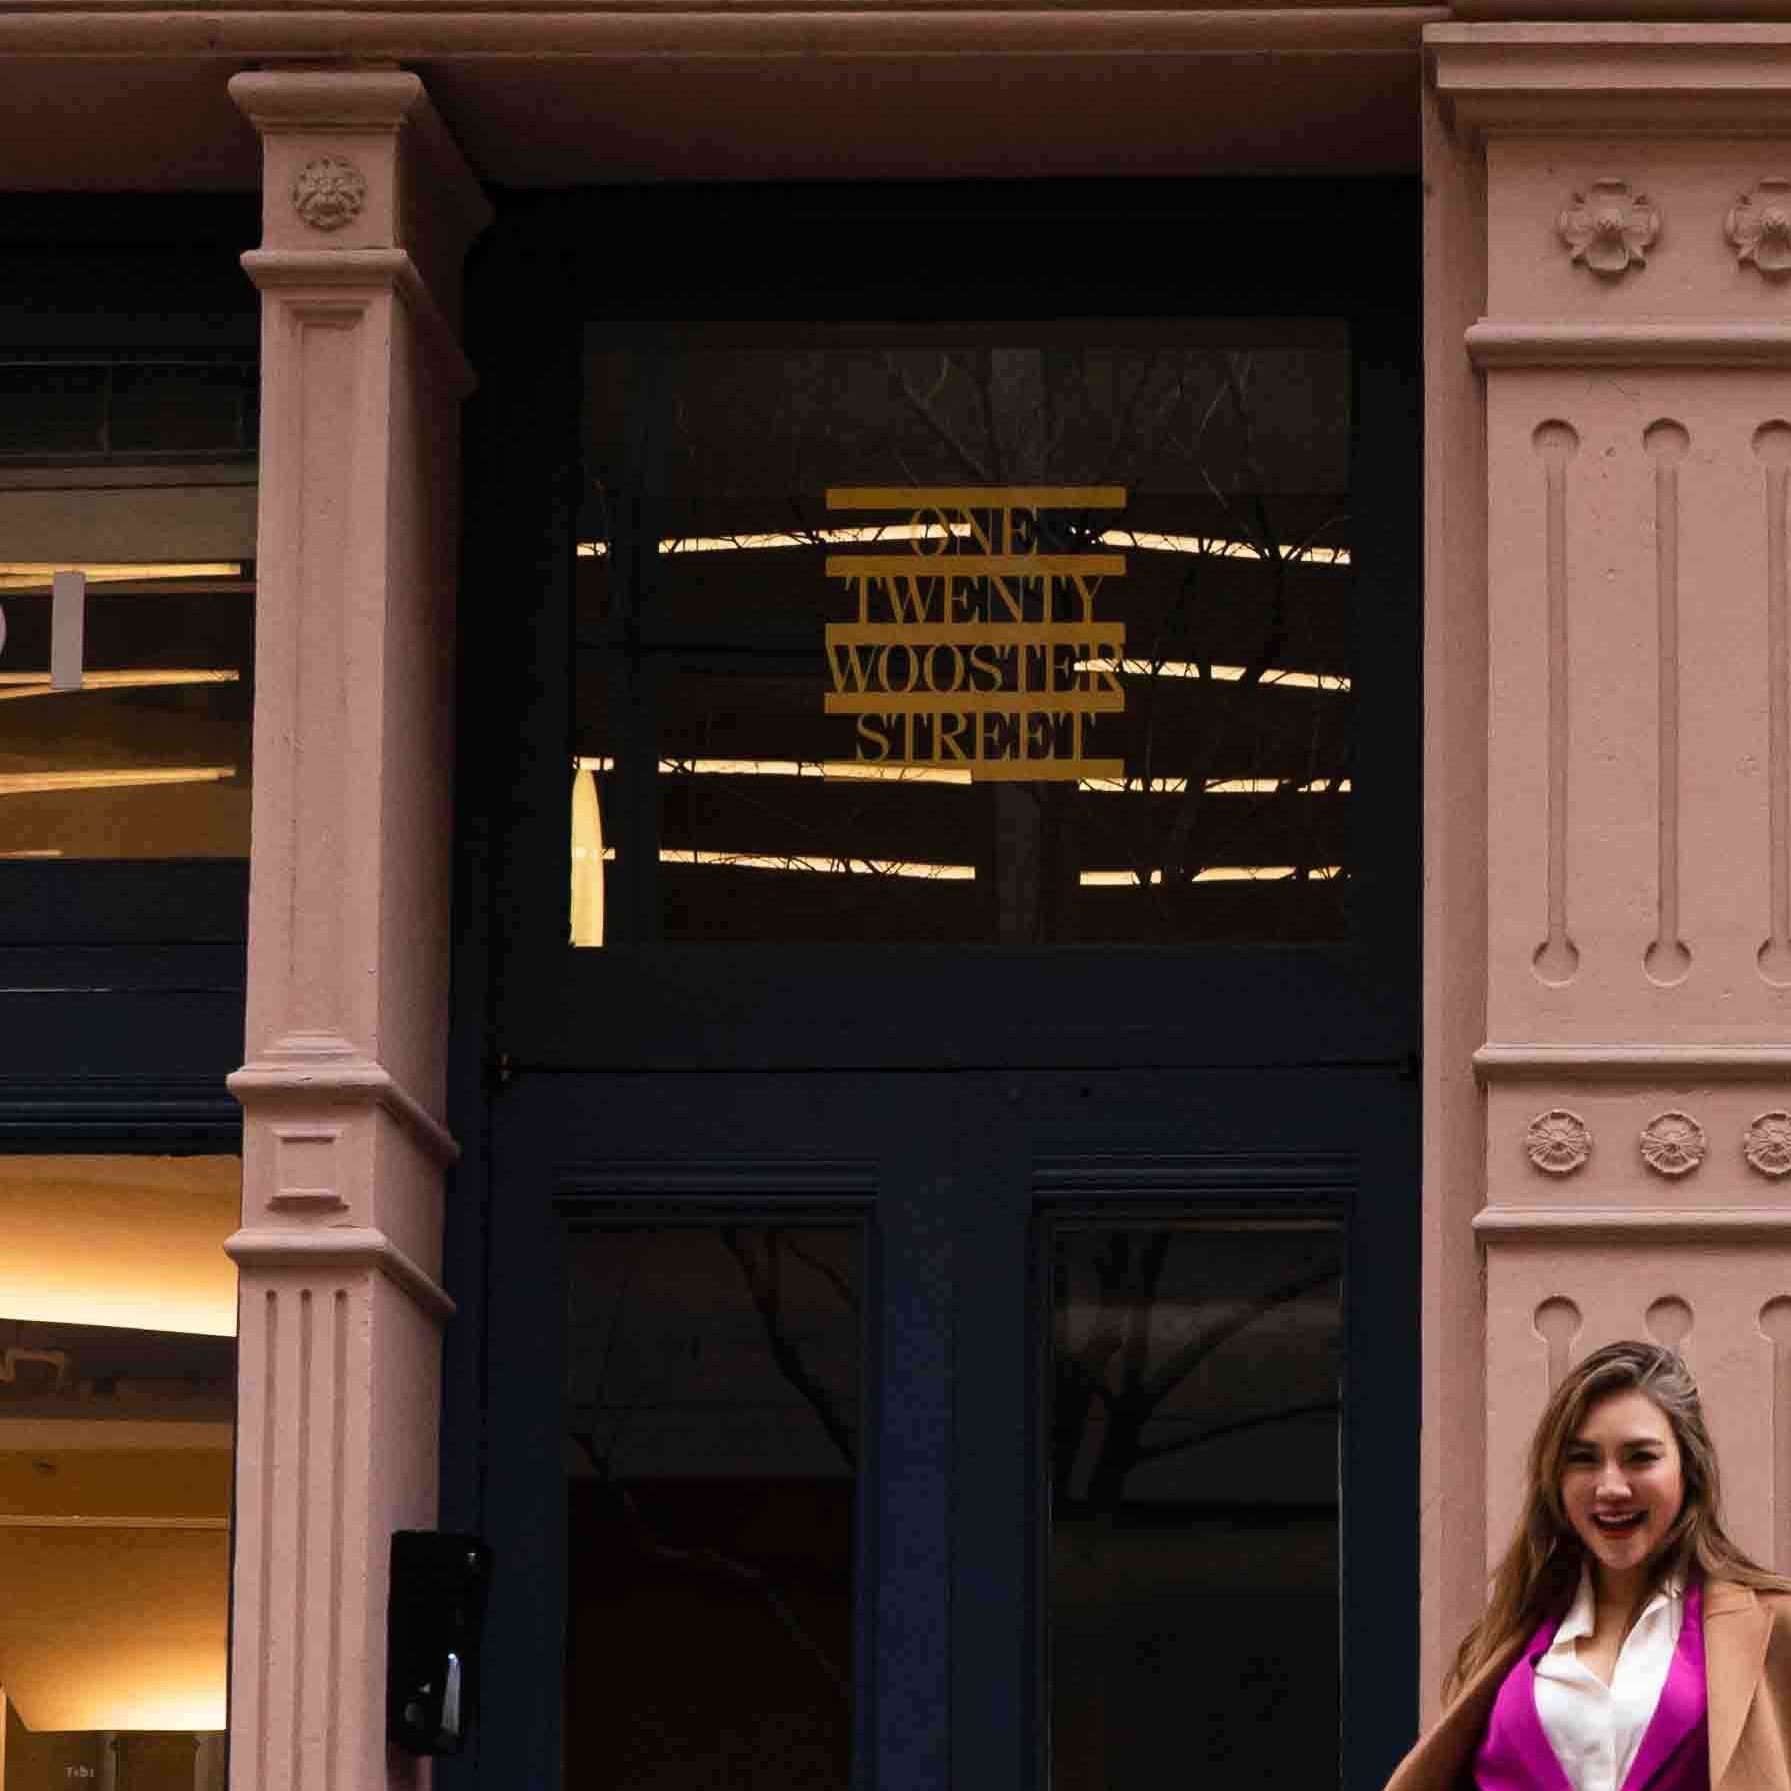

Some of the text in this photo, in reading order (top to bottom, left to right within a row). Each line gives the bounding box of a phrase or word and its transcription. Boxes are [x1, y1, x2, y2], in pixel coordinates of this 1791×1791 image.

[909, 506, 1038, 557] ONE
[844, 575, 1104, 624] TWENTY
[826, 642, 1124, 693] WOOSTER
[855, 711, 1096, 762] STREET
